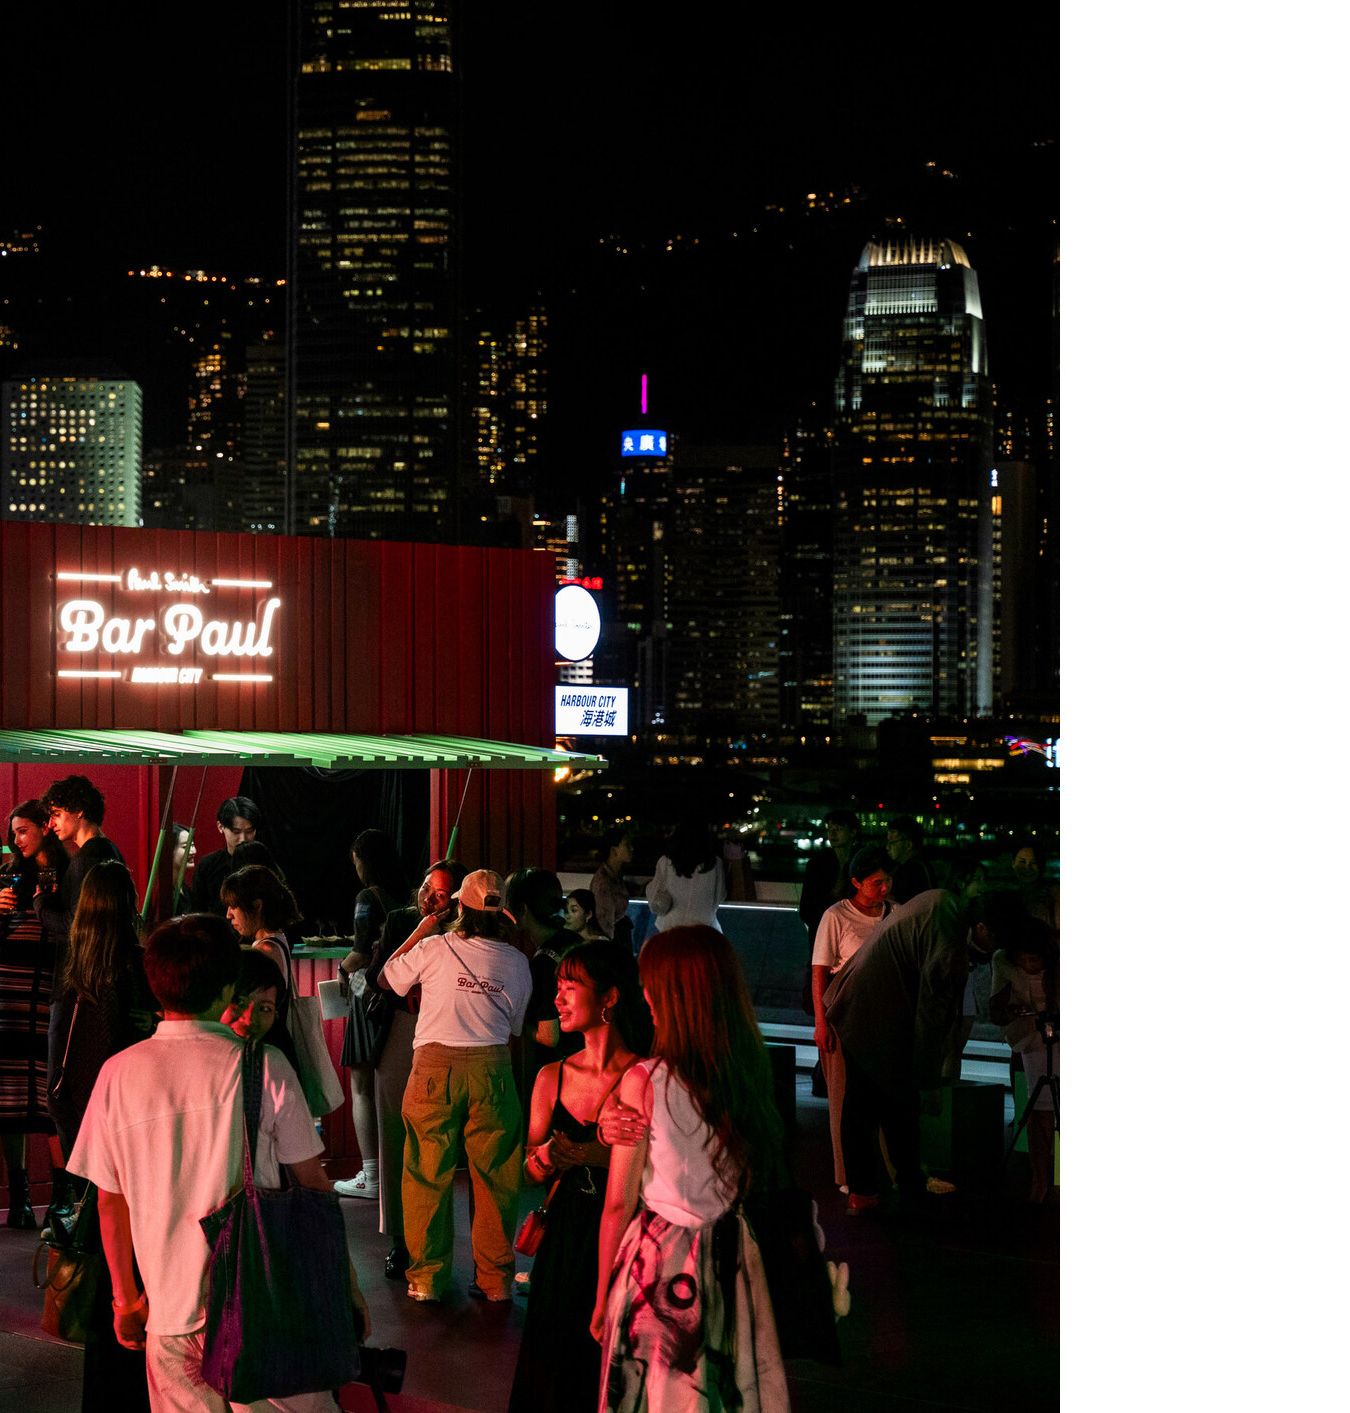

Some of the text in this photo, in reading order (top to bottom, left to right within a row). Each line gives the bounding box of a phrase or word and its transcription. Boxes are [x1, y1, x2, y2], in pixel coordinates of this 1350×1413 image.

[60, 598, 281, 657] Bar Paul
[560, 694, 617, 708] HARBOUR CITY
[580, 709, 617, 727] 海港城
[457, 977, 478, 989] Bar
[479, 981, 505, 993] Paul
